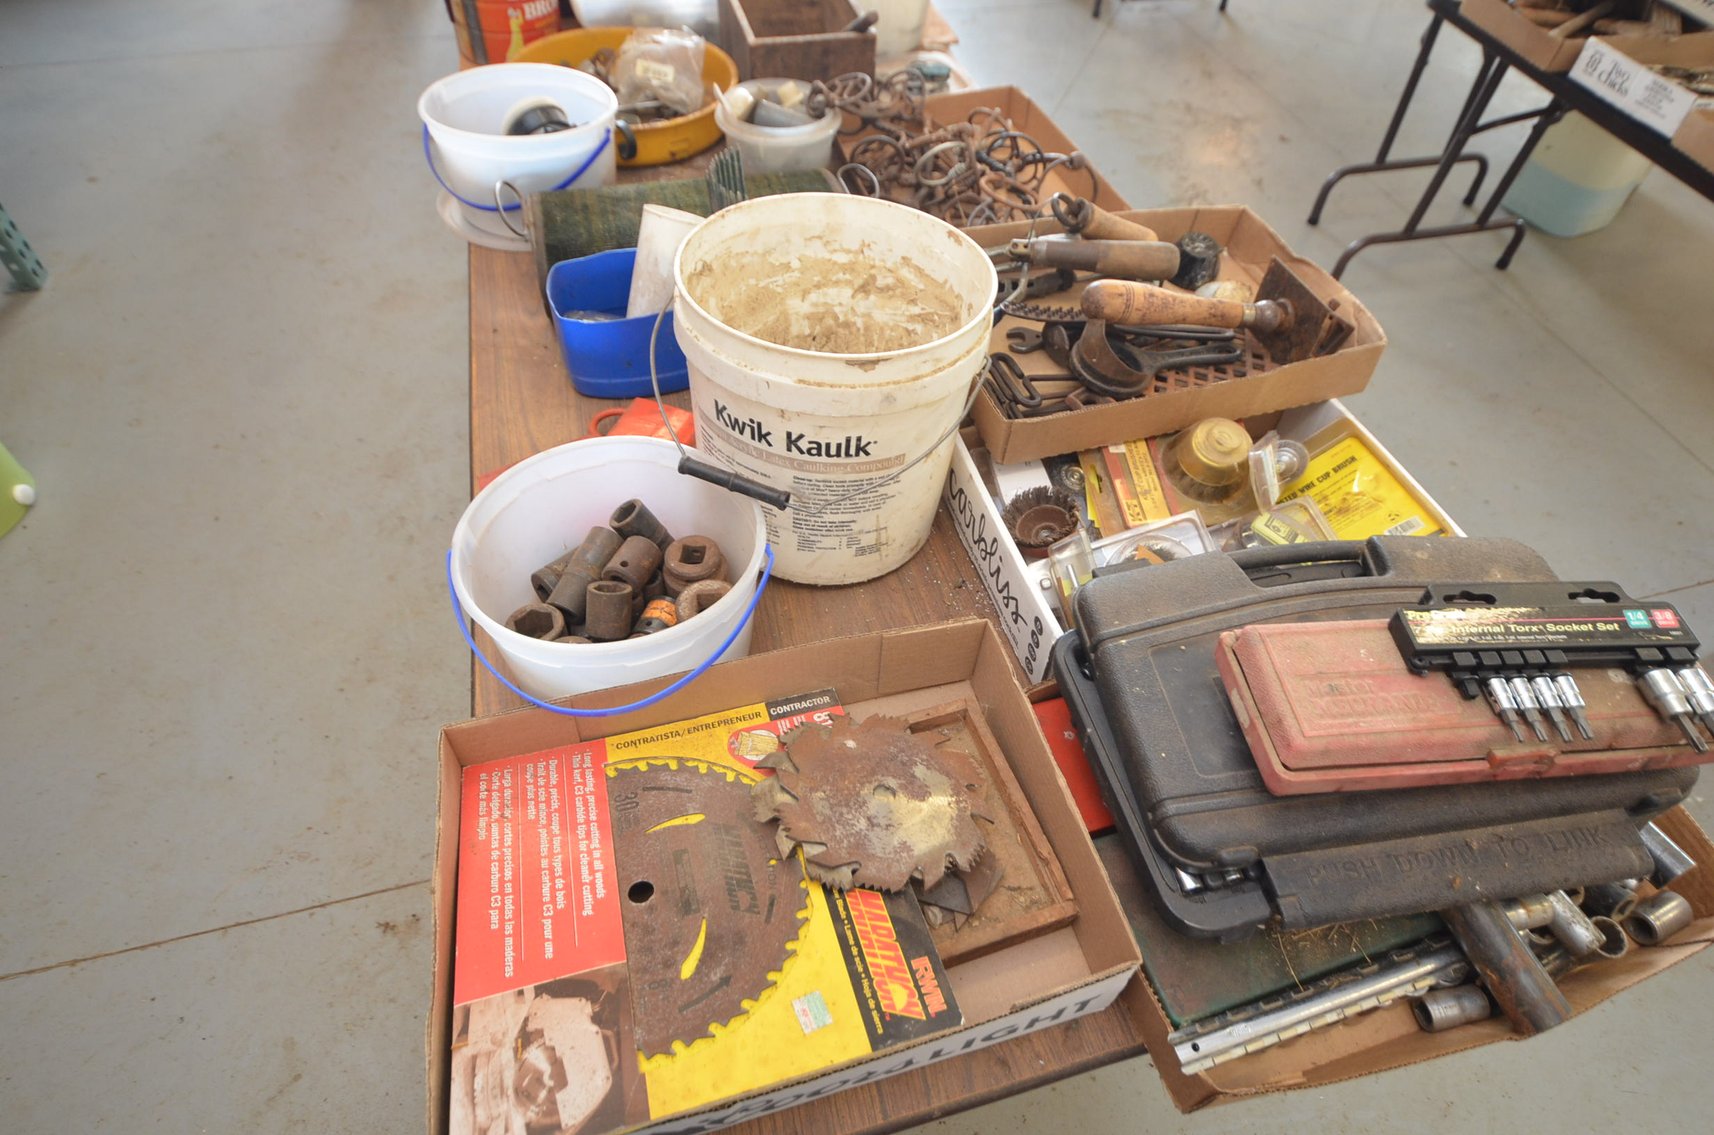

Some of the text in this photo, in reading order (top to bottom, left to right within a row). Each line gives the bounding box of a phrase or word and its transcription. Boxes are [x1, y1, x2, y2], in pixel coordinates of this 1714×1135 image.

[714, 399, 773, 447] Kwik
[785, 431, 872, 458] Kaulk
[1316, 471, 1331, 483] CUP
[1333, 455, 1358, 474] BRUSH
[1546, 623, 1594, 632] Socket
[1597, 622, 1620, 631] Set
[770, 696, 831, 715] CONTRACTOR
[525, 784, 535, 799] plus
[537, 787, 546, 801] scie
[574, 785, 583, 795] C3
[527, 800, 535, 820] nette
[575, 796, 586, 823] carbide
[586, 794, 597, 820] precise
[503, 822, 512, 846] cortes
[549, 812, 559, 834] coupe
[575, 824, 587, 839] tips
[552, 835, 562, 853] tous
[578, 840, 588, 851] for
[588, 821, 601, 849] cutting
[490, 849, 500, 860] de
[501, 847, 513, 880] precisos
[551, 854, 562, 876] types
[592, 859, 603, 869] all
[1304, 857, 1383, 886] PUSH
[1391, 839, 1480, 873] DOWN
[1493, 832, 1529, 859] TO
[490, 861, 500, 893] carburo
[579, 853, 591, 883] cleaner
[503, 882, 512, 893] en
[541, 870, 552, 902] carbure
[554, 877, 565, 889] de
[594, 871, 606, 898] woods
[490, 894, 500, 907] C3
[503, 895, 514, 919] todas
[542, 903, 553, 916] C3
[555, 890, 566, 909] bois
[580, 884, 594, 916] cutting
[489, 909, 499, 929] para
[504, 921, 514, 935] las
[541, 918, 552, 939] pour
[504, 936, 514, 978] maderas
[544, 941, 553, 959] une
[845, 888, 926, 1020] MARATHON
[844, 923, 854, 946] Lame
[854, 956, 863, 973] scie
[861, 977, 872, 998] Hoja
[871, 1011, 884, 1035] sierra
[911, 956, 947, 1014] IRWIN
[929, 993, 1103, 1060] LIGHT
